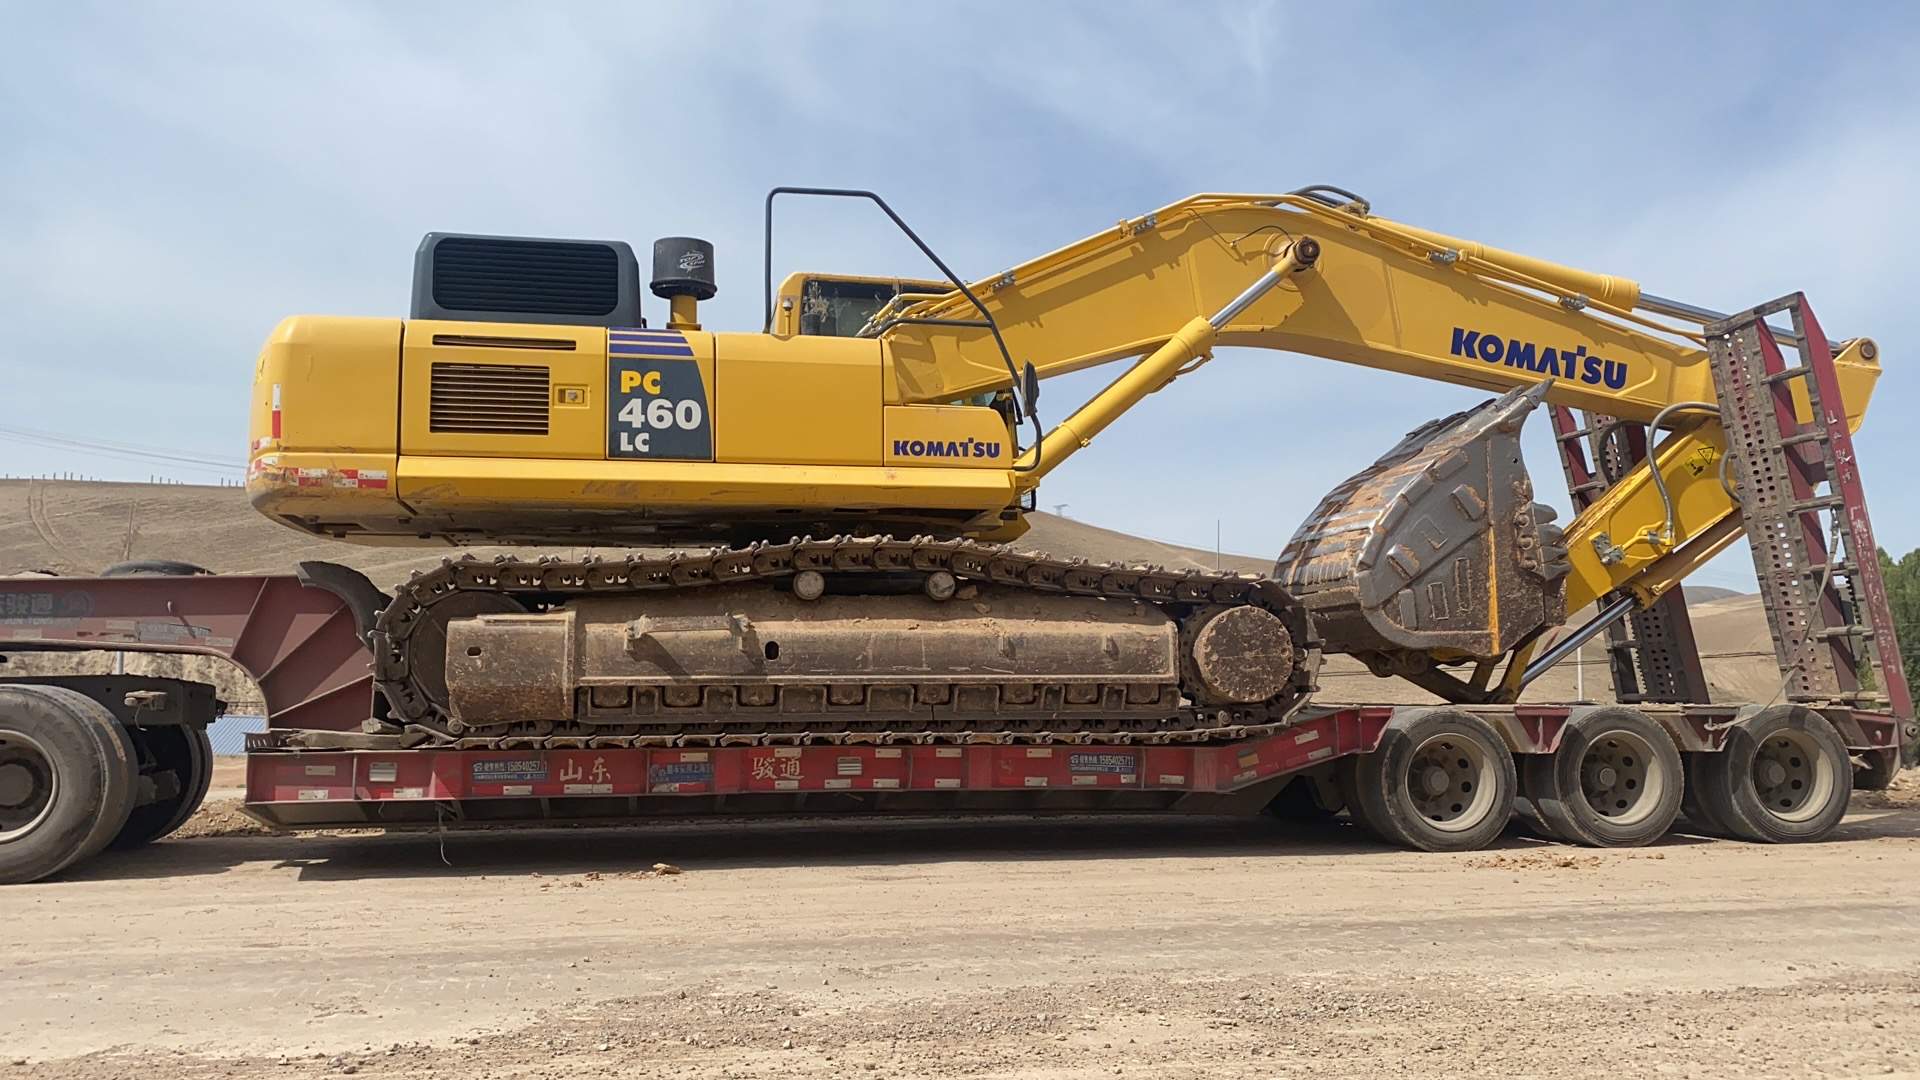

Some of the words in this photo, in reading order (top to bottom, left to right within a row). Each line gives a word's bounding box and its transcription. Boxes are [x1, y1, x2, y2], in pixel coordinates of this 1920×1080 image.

[1451, 327, 1628, 390] KOMATSU
[620, 370, 661, 395] PC
[618, 398, 702, 430] 460
[620, 432, 649, 452] LC
[893, 437, 1000, 458] KOMATSU
[0, 593, 53, 615] 骏通
[560, 756, 611, 783] 山东
[751, 756, 805, 780] 骏通
